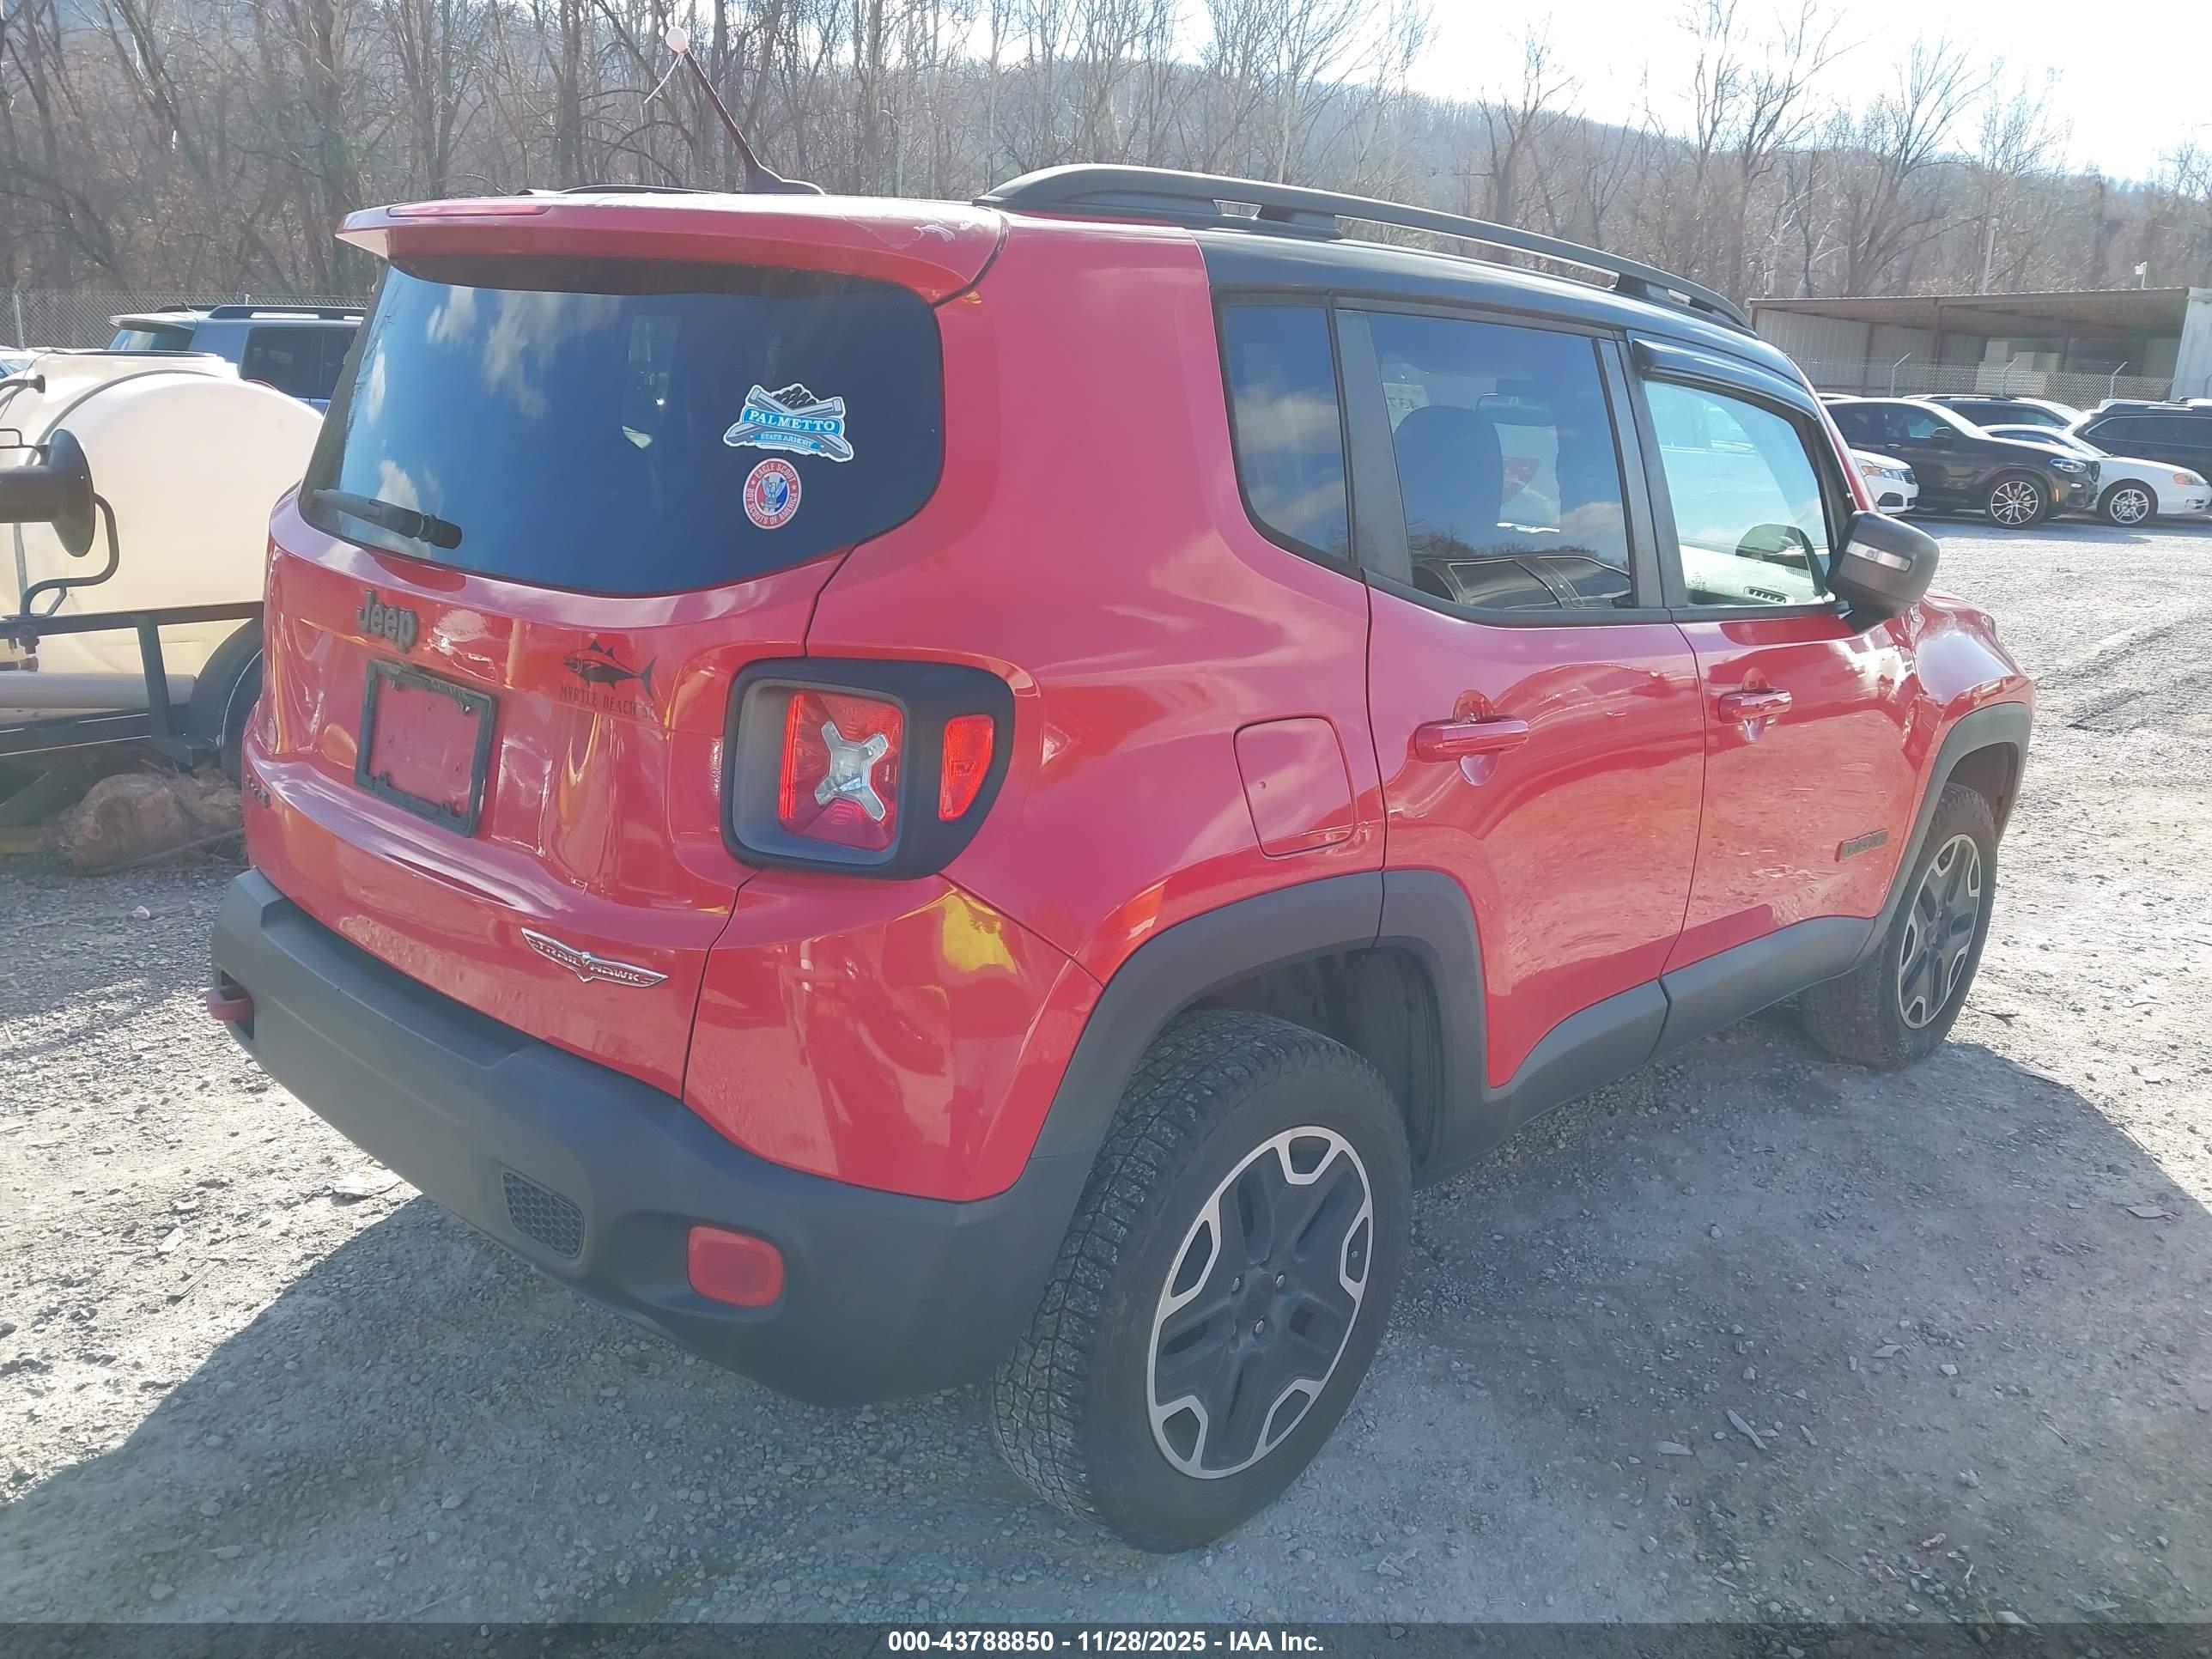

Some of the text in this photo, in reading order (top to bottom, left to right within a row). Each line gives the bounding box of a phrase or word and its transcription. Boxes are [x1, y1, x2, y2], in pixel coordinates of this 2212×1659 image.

[748, 410, 836, 431] PALMETTO
[755, 464, 796, 482] EAGLE SCOUT
[747, 503, 769, 525] SCOUTS
[779, 493, 798, 521] AMERICA
[356, 589, 418, 653] Jeep
[560, 685, 599, 705] MYRTLE
[603, 695, 637, 715] BEACH
